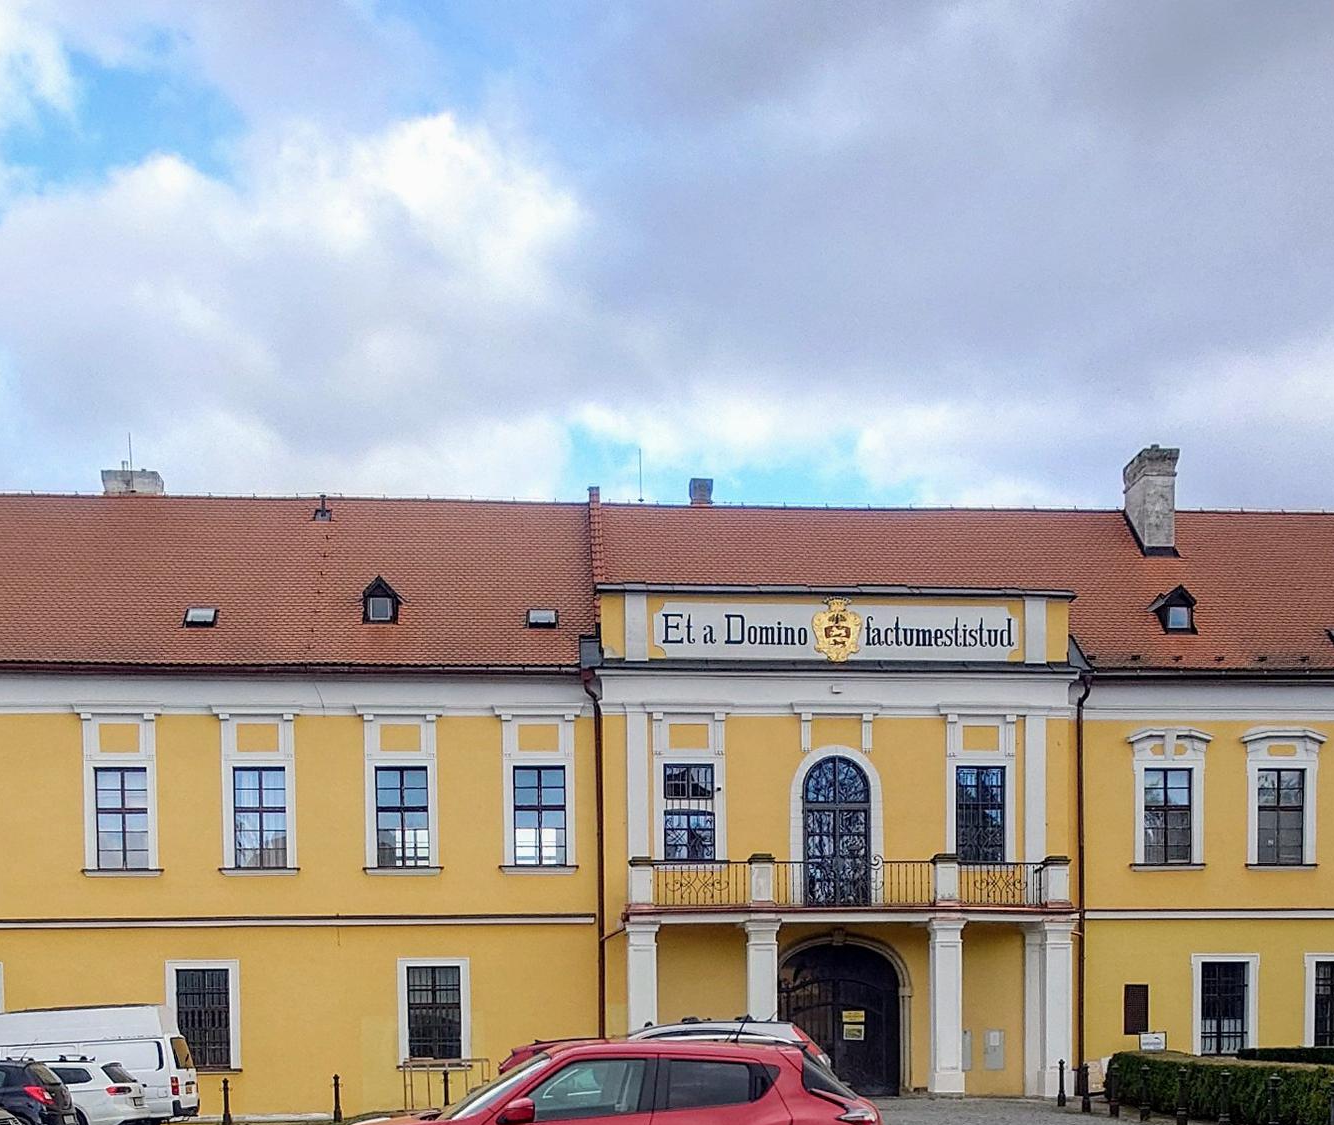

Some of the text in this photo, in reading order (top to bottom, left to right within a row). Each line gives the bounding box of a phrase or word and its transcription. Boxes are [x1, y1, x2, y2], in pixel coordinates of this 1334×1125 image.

[662, 613, 696, 644] Et
[703, 624, 717, 644] a
[724, 614, 809, 646] Domino
